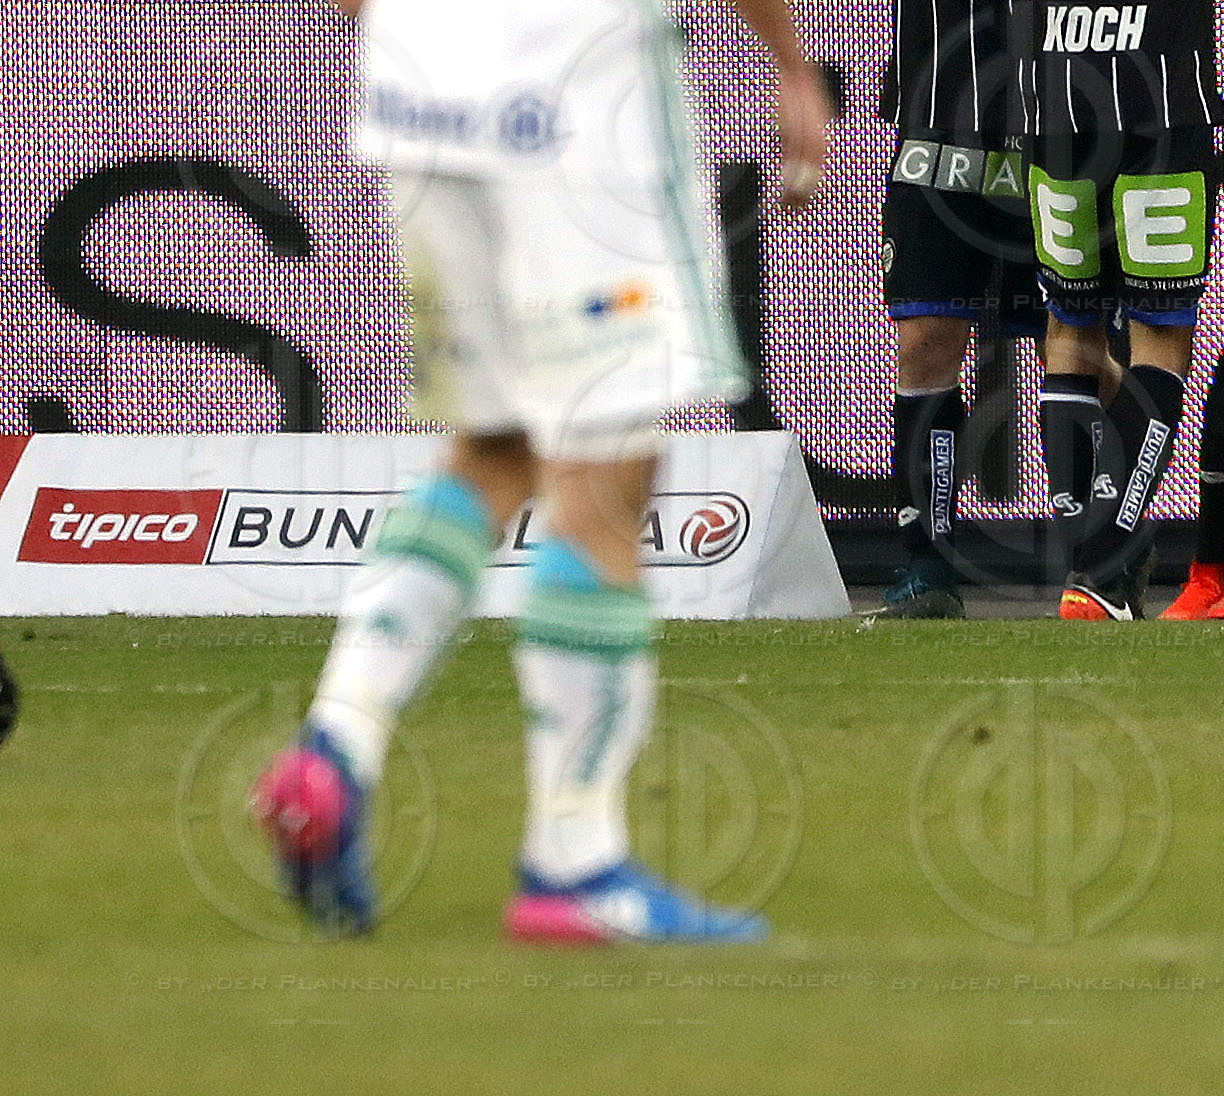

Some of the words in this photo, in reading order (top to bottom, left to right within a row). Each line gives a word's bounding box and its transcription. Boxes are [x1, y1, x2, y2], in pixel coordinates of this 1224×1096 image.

[1042, 5, 1148, 52] KOCH
[1036, 183, 1084, 267] E
[1121, 187, 1195, 264] E
[935, 435, 953, 535] PUNTIGAMER
[1120, 428, 1168, 529] PUNTIGAMER
[49, 502, 198, 549] tipico
